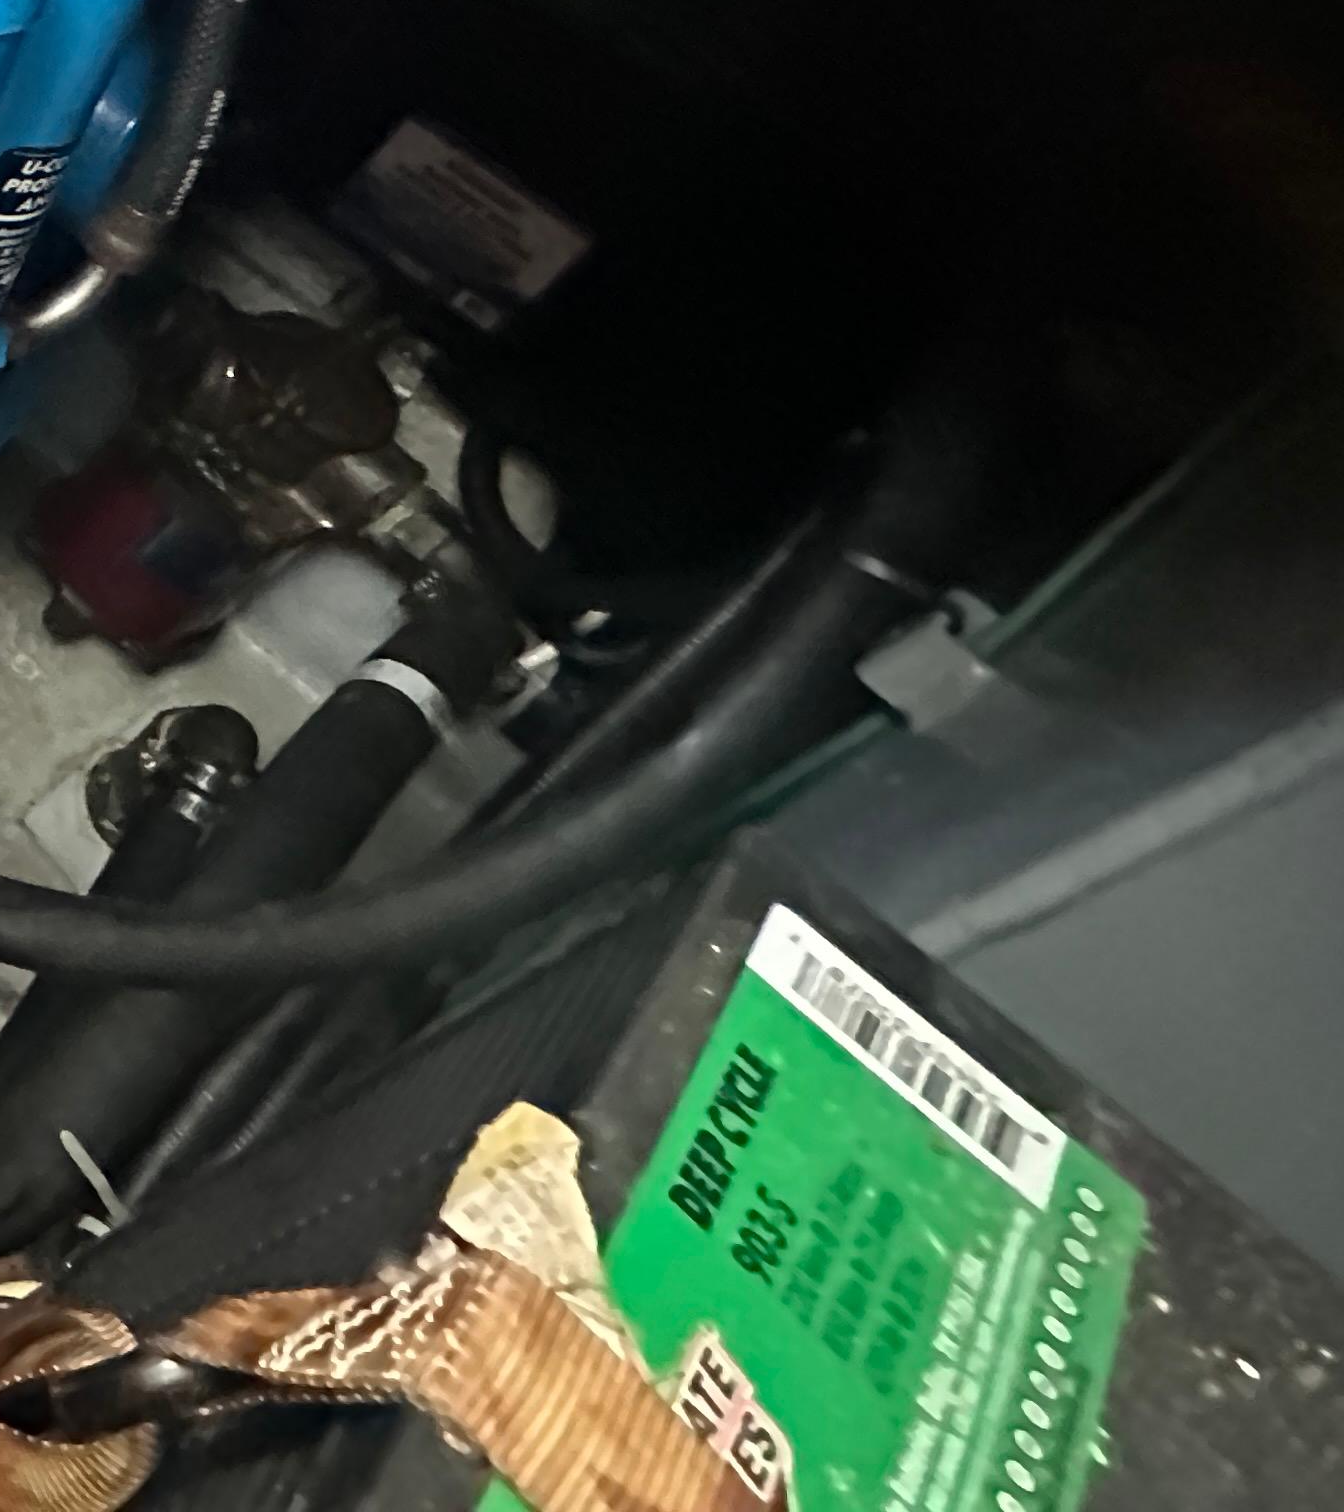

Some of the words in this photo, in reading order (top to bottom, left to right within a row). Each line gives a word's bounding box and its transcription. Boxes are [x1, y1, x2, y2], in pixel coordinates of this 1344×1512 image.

[668, 1129, 736, 1232] DEEP
[707, 1042, 779, 1148] CYCLE
[731, 1411, 777, 1491] ES
